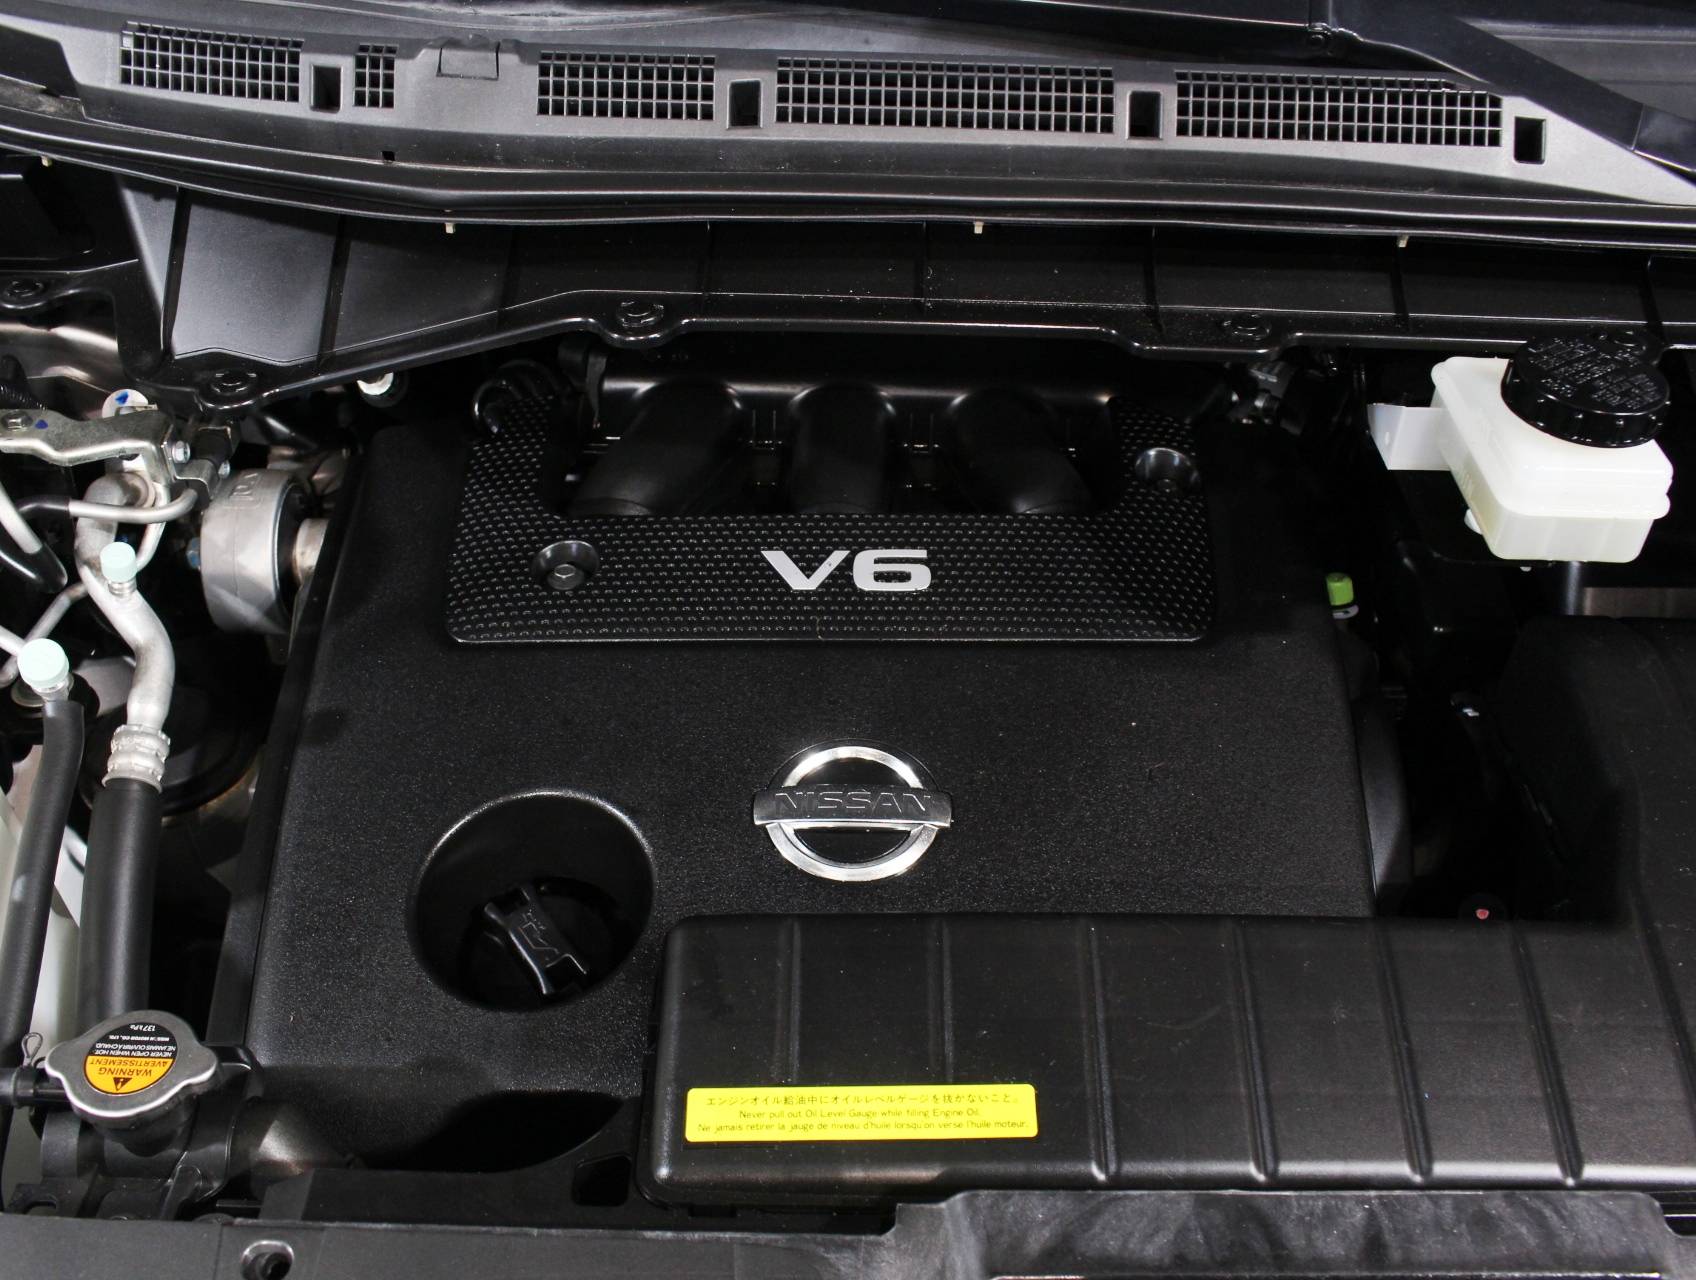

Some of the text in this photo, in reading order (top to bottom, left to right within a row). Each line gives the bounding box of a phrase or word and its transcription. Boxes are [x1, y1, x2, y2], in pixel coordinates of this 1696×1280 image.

[760, 549, 932, 592] V6
[774, 790, 932, 816] NISSAN
[89, 1059, 168, 1067] AVERTISSEMENT
[98, 1068, 152, 1077] WARNING
[739, 1110, 766, 1118] Never
[769, 1109, 784, 1119] pull
[787, 1110, 803, 1118] out
[805, 1109, 817, 1118] Oil
[820, 1109, 845, 1117] Level
[849, 1109, 877, 1118] Gauge
[882, 1109, 903, 1117] while
[906, 1108, 929, 1118] filling
[933, 1108, 963, 1118] Engine
[698, 1124, 711, 1132] Ne
[715, 1123, 742, 1133] jamais
[746, 1123, 774, 1131] retirer
[778, 1122, 786, 1130] la
[789, 1122, 813, 1133] jauge
[817, 1122, 829, 1130] de
[831, 1122, 860, 1130] niveau
[863, 1121, 891, 1130] d'huile
[894, 1121, 935, 1131] lorsqu'on
[966, 1120, 991, 1129] l'huile
